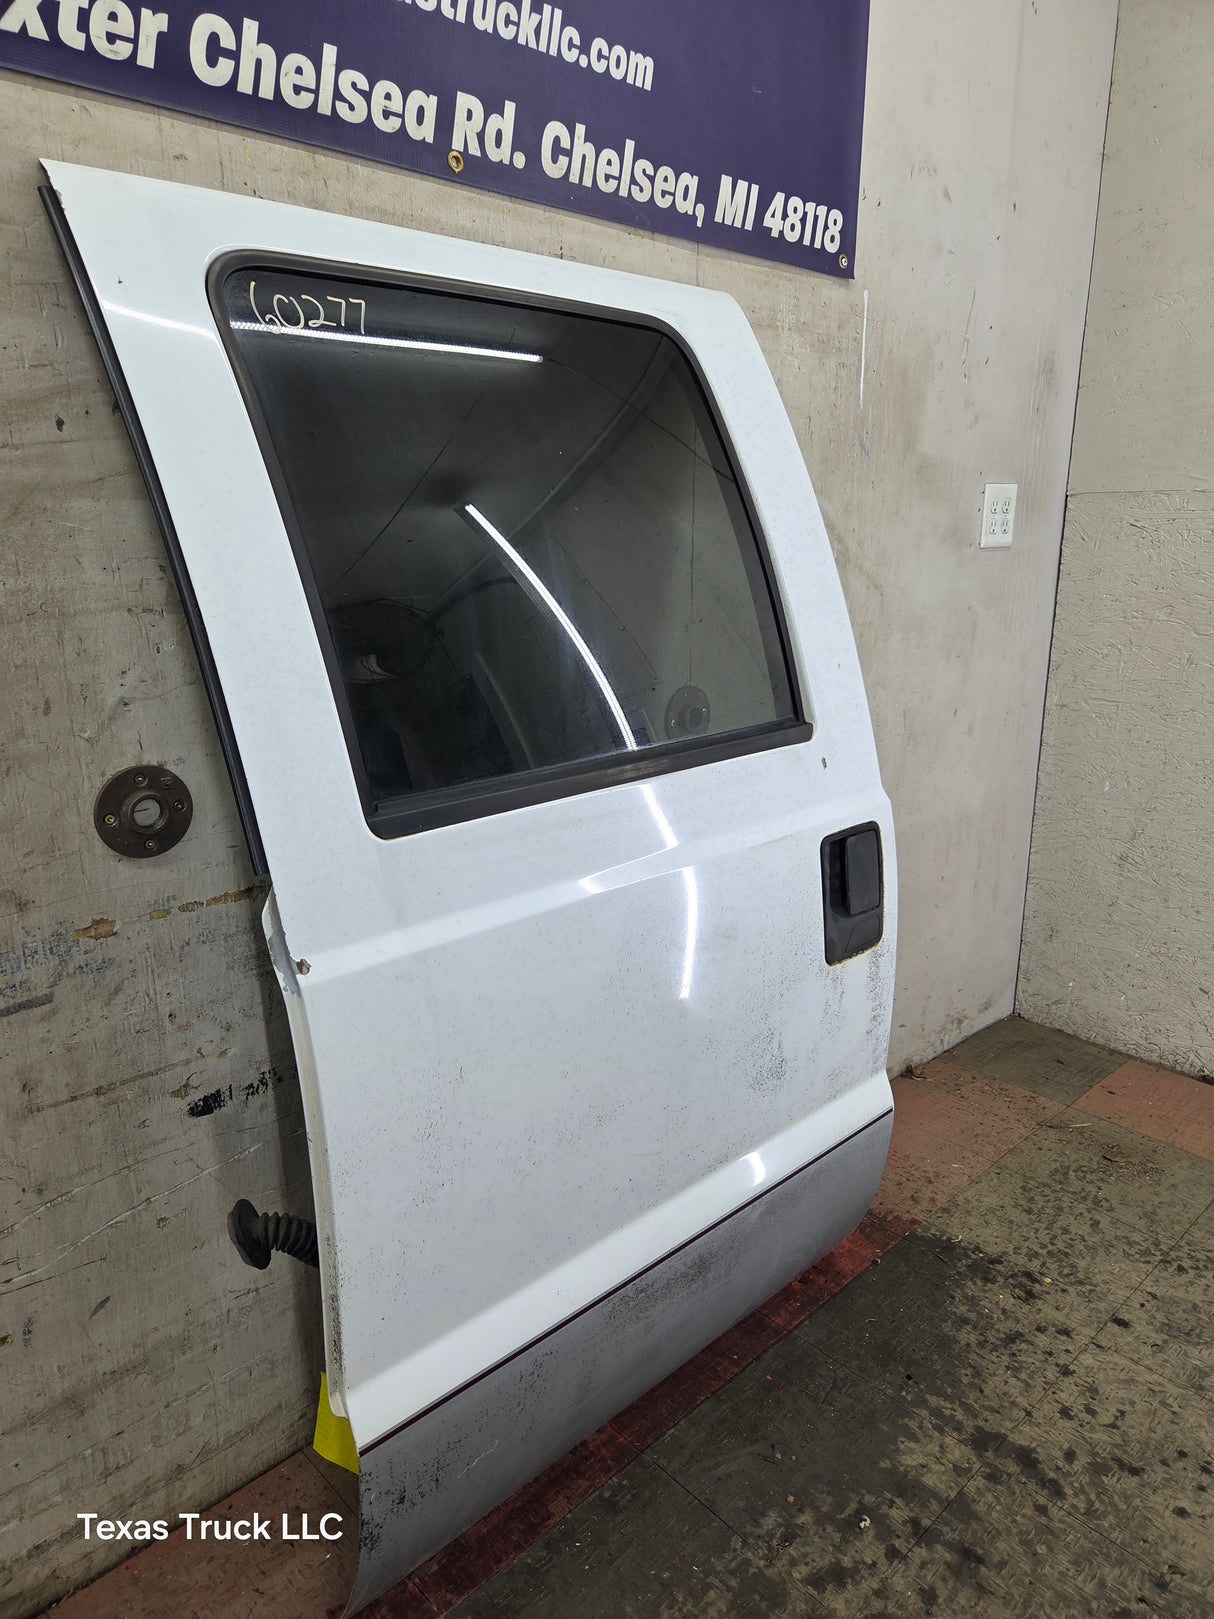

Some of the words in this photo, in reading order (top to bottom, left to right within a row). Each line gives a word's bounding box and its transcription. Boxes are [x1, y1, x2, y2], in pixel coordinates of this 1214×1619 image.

[189, 13, 439, 144] Chelsea
[451, 91, 527, 169] Rd.
[540, 120, 706, 228] Chelsea,
[714, 174, 760, 231] MI
[763, 192, 844, 254] 48118
[250, 281, 366, 334] 60277
